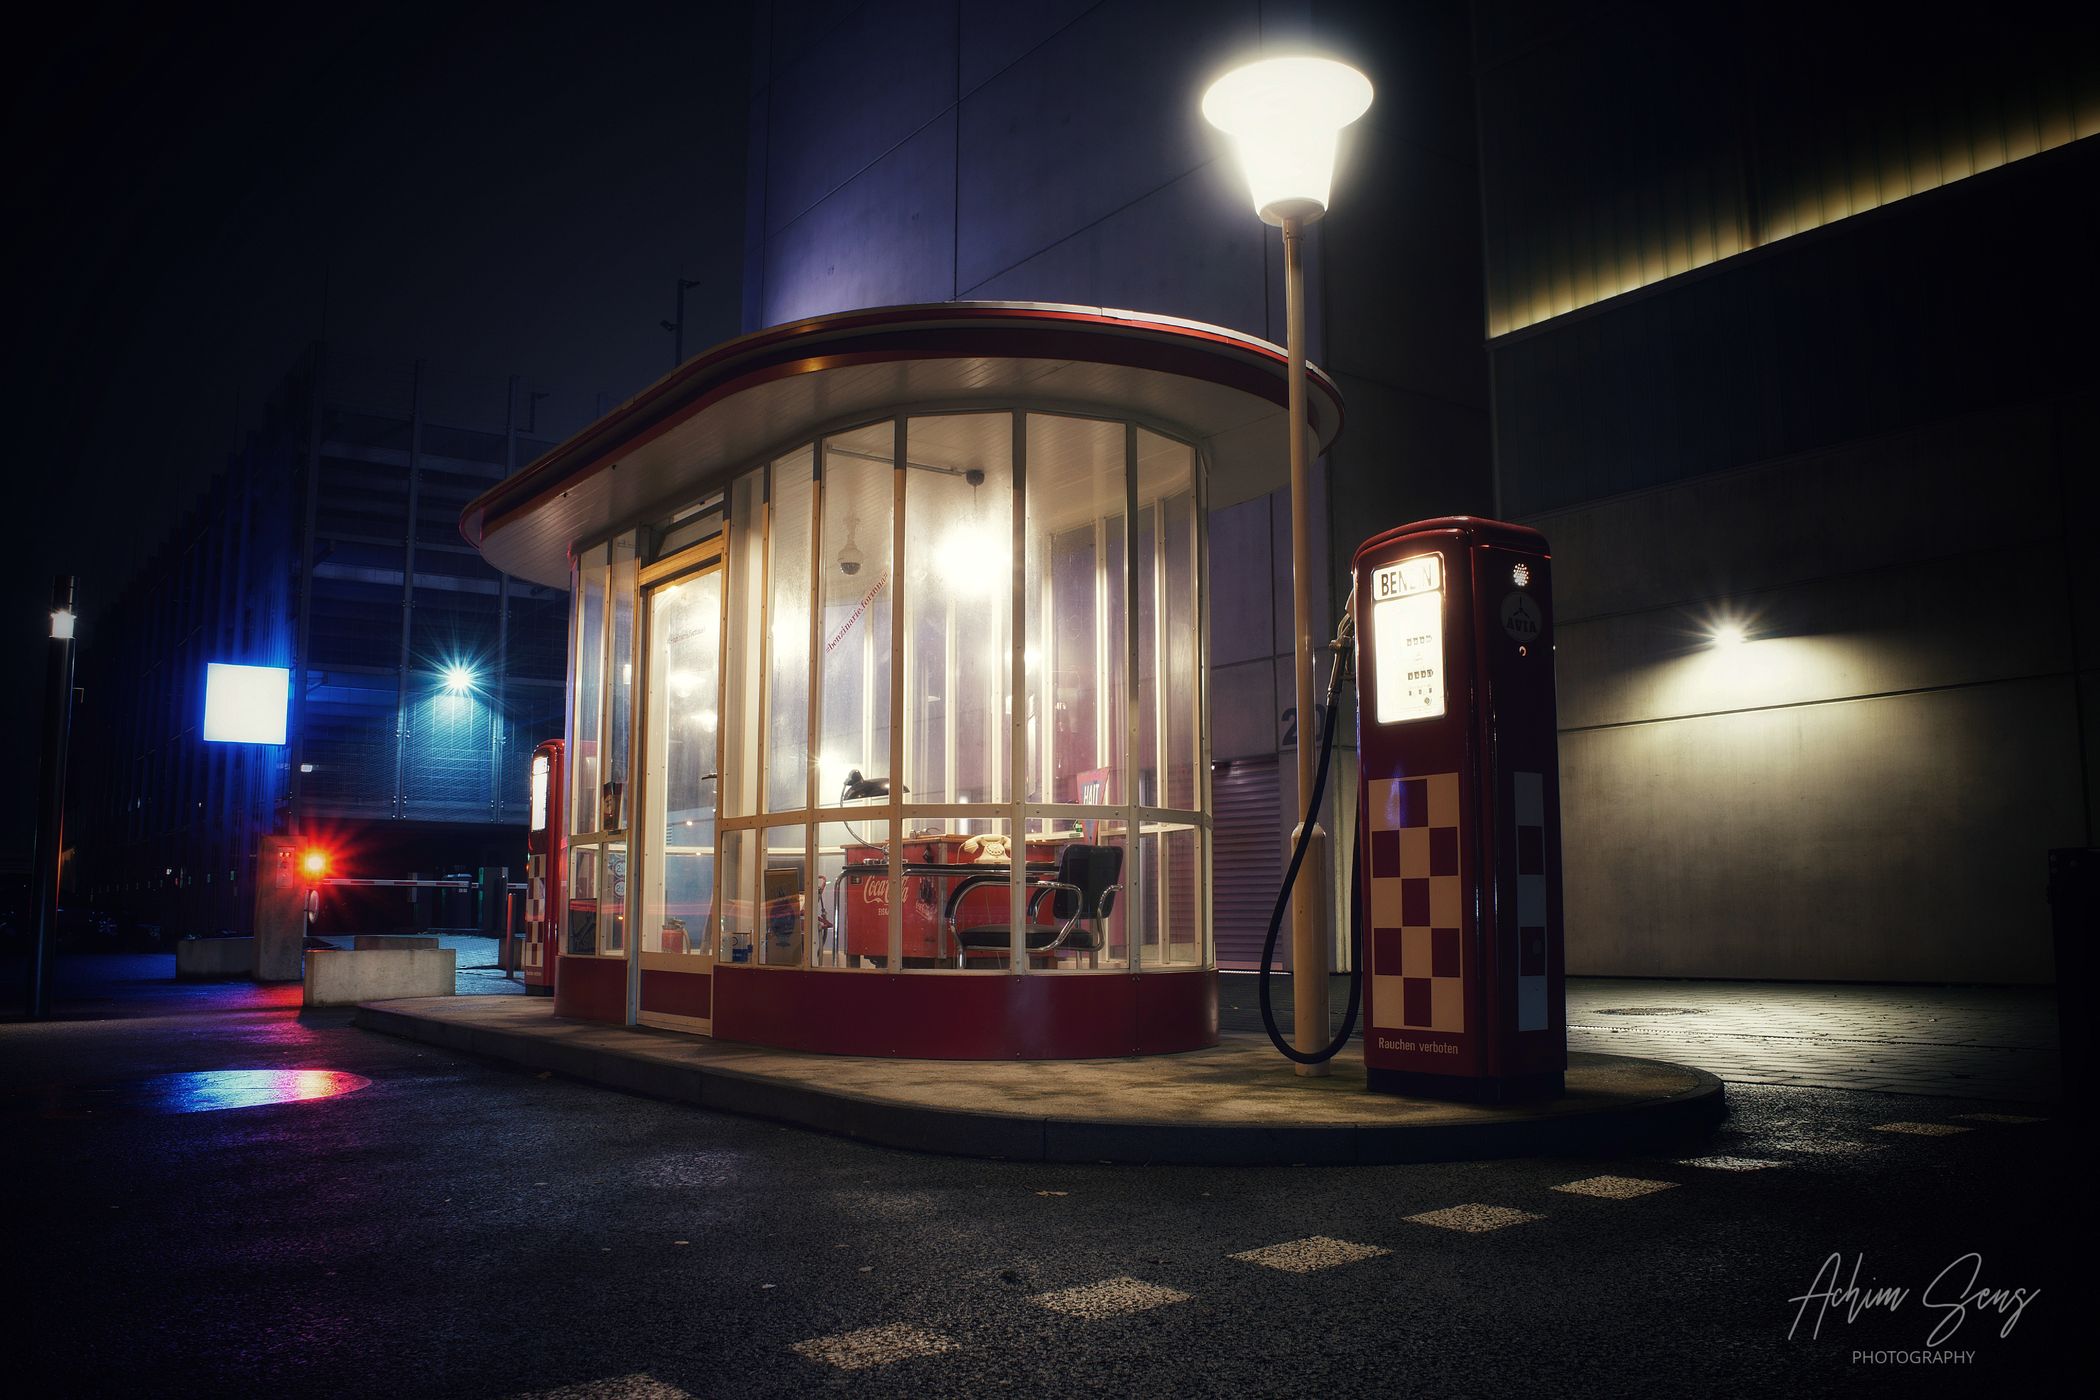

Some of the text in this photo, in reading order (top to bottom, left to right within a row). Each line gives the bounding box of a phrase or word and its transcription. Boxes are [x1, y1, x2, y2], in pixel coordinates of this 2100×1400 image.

[1381, 563, 1432, 596] BENN
[1506, 616, 1537, 633] AVIA
[1378, 1037, 1459, 1055] Rauchen verboten
